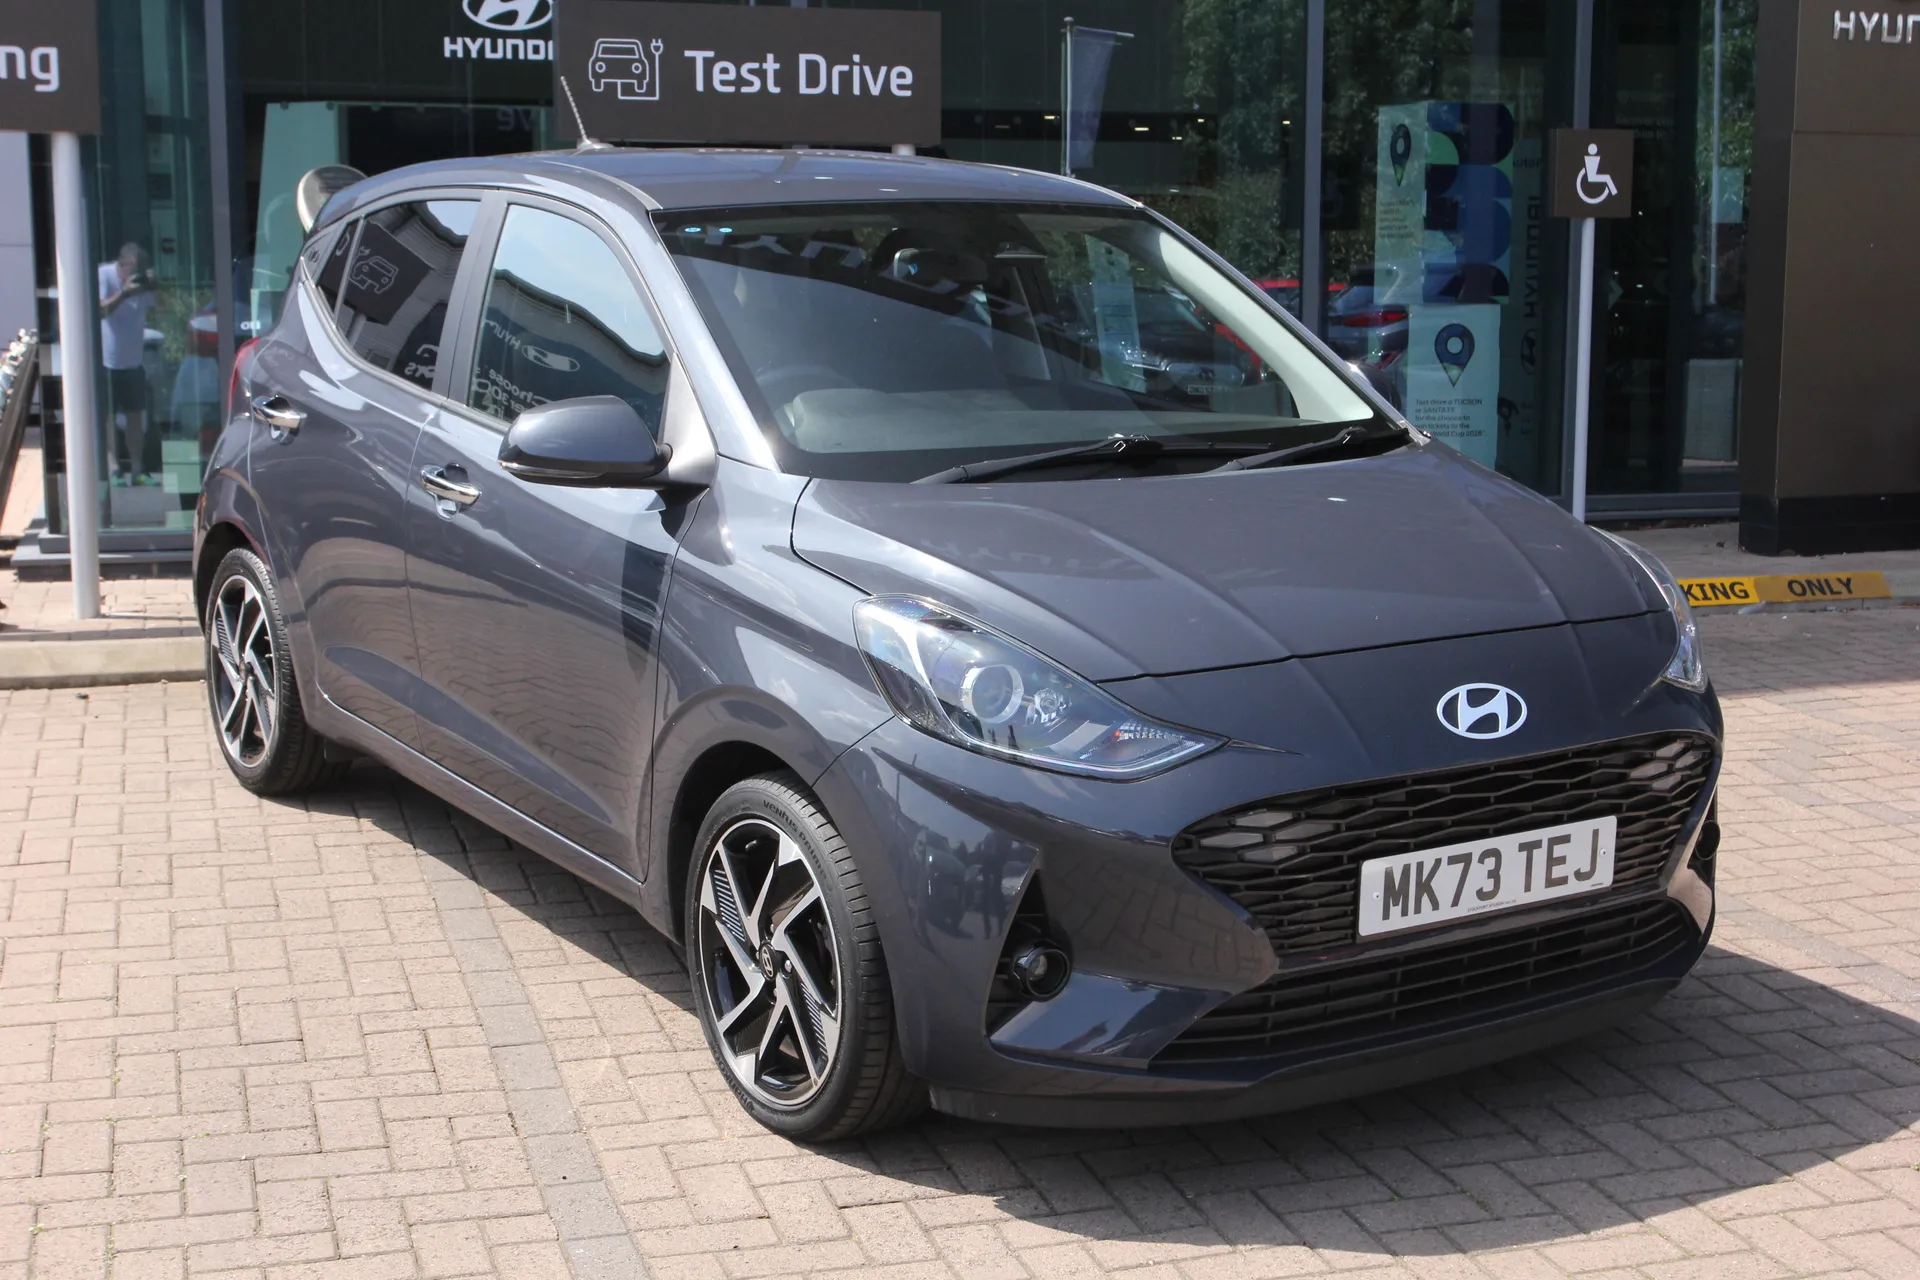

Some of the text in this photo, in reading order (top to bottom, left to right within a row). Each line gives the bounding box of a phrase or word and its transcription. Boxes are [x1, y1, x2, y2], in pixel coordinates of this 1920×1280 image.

[443, 36, 554, 60] HYUND
[684, 50, 913, 97] Test Drive
[1787, 577, 1853, 597] ONLY
[1382, 828, 1600, 921] MK73 TEJ
